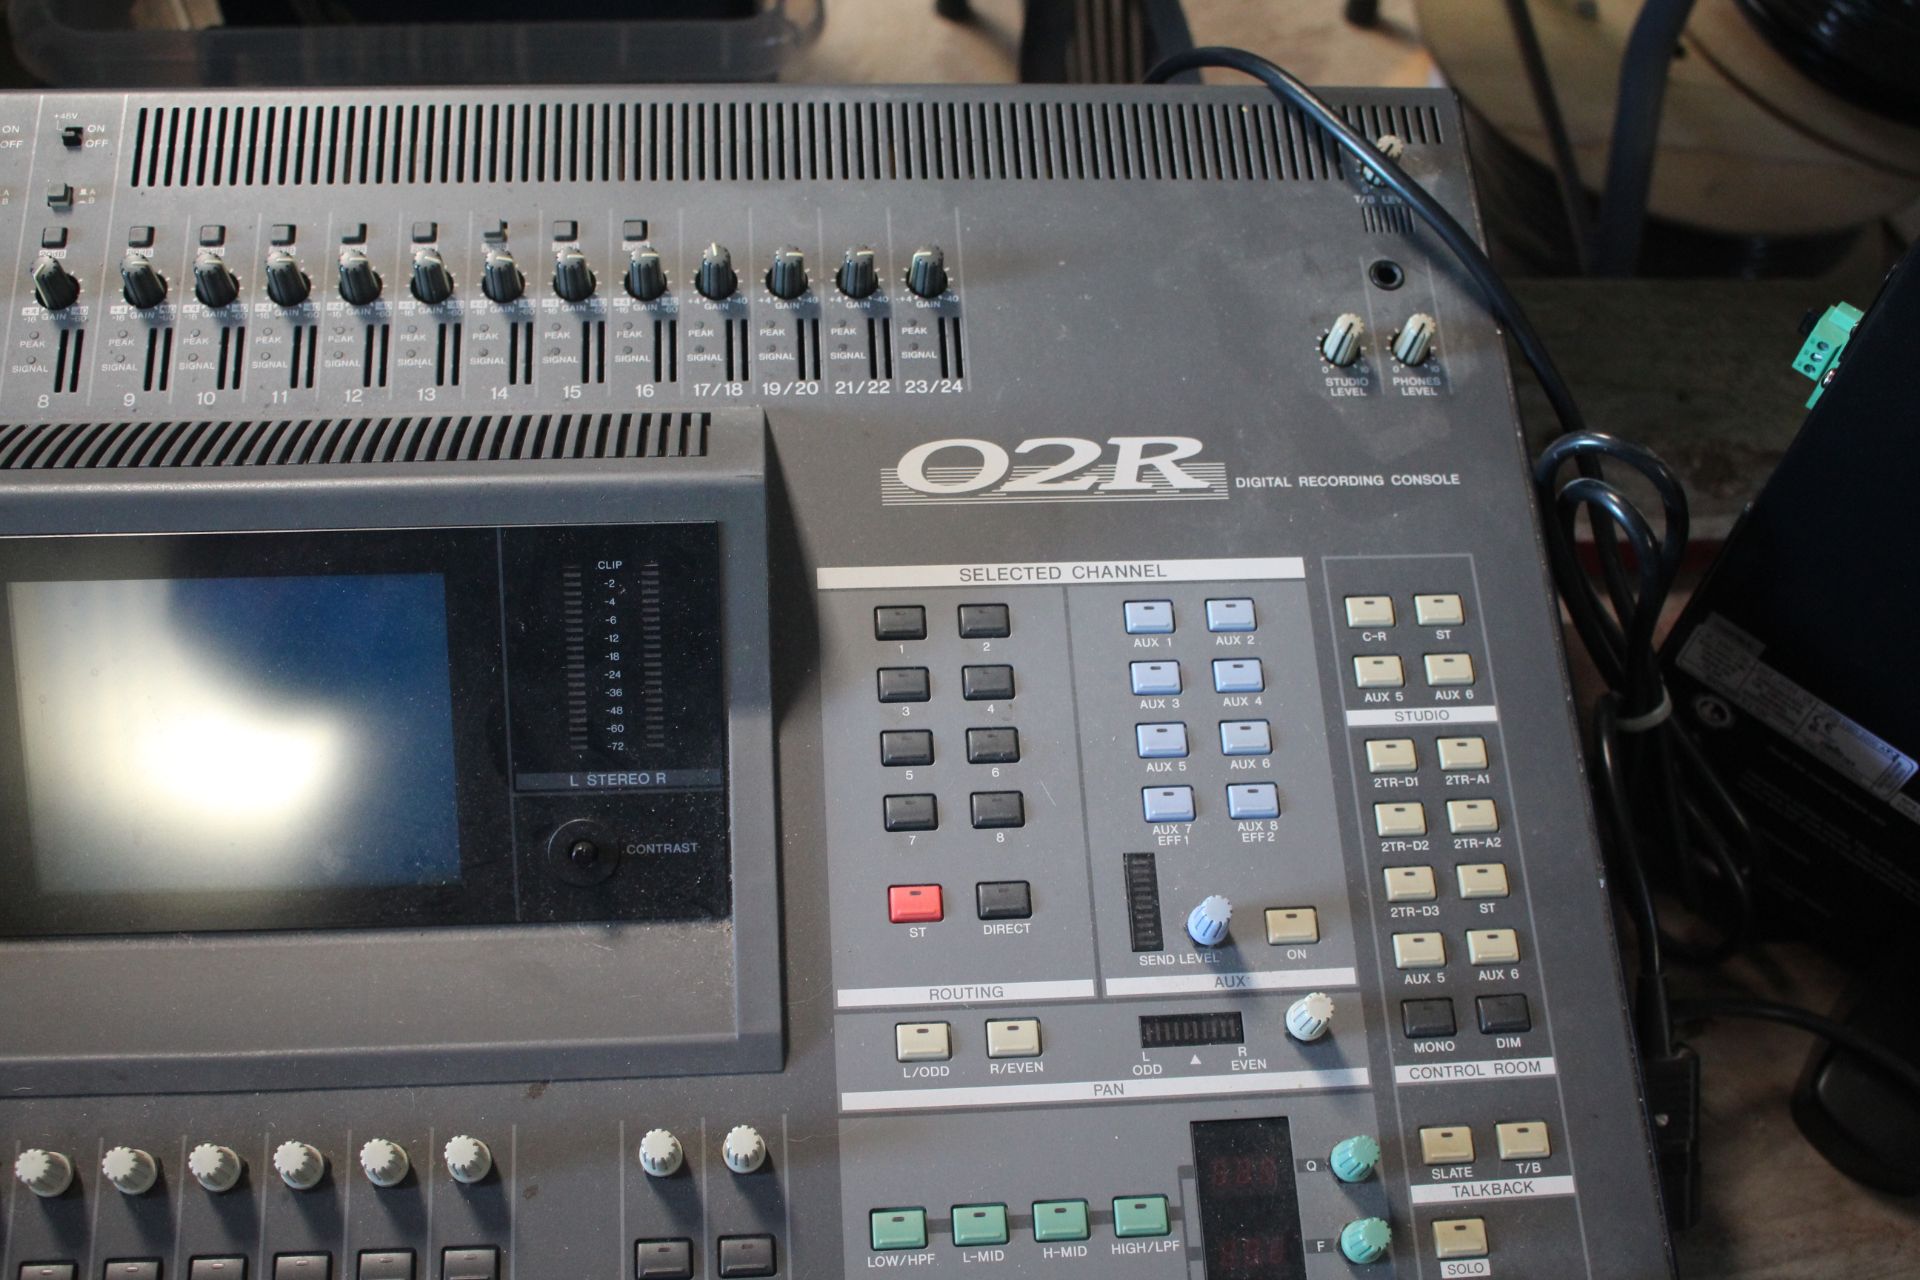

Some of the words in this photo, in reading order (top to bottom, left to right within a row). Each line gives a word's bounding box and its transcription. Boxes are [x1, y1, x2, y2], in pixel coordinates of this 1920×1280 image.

[2, 125, 20, 133] ON
[0, 140, 23, 148] OFF
[86, 140, 108, 148] OFF
[835, 381, 890, 394] 21/22
[905, 380, 963, 393] 23/24
[1326, 378, 1368, 387] STUDIO
[1393, 378, 1440, 386] PHONES
[491, 387, 508, 400] 14
[563, 385, 581, 398] 15
[636, 385, 654, 397] 16
[694, 383, 743, 396] 17/18
[763, 382, 818, 395] 19/20
[1331, 387, 1366, 396] LEVEL
[1401, 387, 1437, 395] LEVEL
[124, 393, 135, 406] 9
[197, 392, 215, 405] 10
[272, 391, 288, 403] 11
[345, 389, 363, 402] 12
[418, 388, 436, 401] 13
[38, 395, 49, 408] 8
[1236, 476, 1291, 488] DIGITAL
[1299, 475, 1384, 487] RECORDING
[1391, 473, 1460, 486] CONSOLE
[598, 561, 622, 569] CLIP
[959, 565, 1061, 582] SELECTED
[1072, 563, 1167, 579] CHANNEL
[1363, 632, 1386, 642] C-R
[1436, 630, 1451, 639] ST
[1134, 639, 1159, 647] AUX
[1216, 637, 1240, 645] AUX
[1248, 636, 1255, 644] 2
[983, 642, 990, 651] 2
[604, 671, 621, 679] -24
[1365, 693, 1389, 702] AUX
[1396, 692, 1403, 701] 5
[1435, 691, 1460, 700] AUX
[1466, 690, 1474, 699] 6
[1140, 700, 1165, 709] AUX
[1172, 699, 1180, 708] 3
[1223, 697, 1248, 706] AUX
[1255, 697, 1262, 705] 4
[903, 707, 910, 716] 3
[987, 704, 994, 713] 4
[1395, 710, 1450, 722] STUDIO
[1147, 763, 1172, 772] AUX
[1179, 762, 1186, 771] 5
[1230, 760, 1256, 769] AUX
[1263, 759, 1270, 768] 6
[906, 771, 913, 780] 5
[992, 768, 999, 777] 6
[570, 776, 579, 786] L
[587, 773, 649, 785] STEREO
[656, 773, 666, 784] R
[1374, 778, 1418, 788] 2TR-D1
[1446, 775, 1490, 785] 2TR-A1
[1153, 825, 1179, 834] AUX
[1185, 825, 1192, 834] 7
[1238, 822, 1263, 831] AUX
[1271, 821, 1278, 830] 8
[909, 836, 916, 845] 7
[996, 833, 1004, 843] 8
[1159, 836, 1181, 846] EFF
[1242, 833, 1264, 842] EFF
[1267, 833, 1275, 841] 2
[627, 843, 698, 854] CONTRAST
[1381, 841, 1429, 852] 2TR-D2
[1454, 838, 1501, 849] 2TR-A2
[1391, 906, 1440, 917] 2TR-D3
[1480, 904, 1495, 913] ST
[910, 928, 926, 938] ST
[984, 924, 1031, 935] DIRECT
[1140, 954, 1175, 966] SEND
[1180, 952, 1220, 964] LEVEL
[1287, 950, 1307, 960] ON
[1405, 974, 1431, 984] AUX
[1438, 973, 1445, 983] 5
[1479, 970, 1505, 981] AUX
[1511, 969, 1519, 979] 6
[1215, 976, 1246, 988] AUX
[929, 986, 1004, 1000] ROUTING
[1414, 1041, 1455, 1053] MONO
[1496, 1038, 1521, 1048] DIM
[1142, 1052, 1150, 1061] L
[1238, 1047, 1247, 1056] R
[990, 1062, 1044, 1074] R/EVEN
[1132, 1064, 1162, 1076] ODD
[1231, 1059, 1267, 1070] EVEN
[903, 1067, 950, 1078] L/ODD
[1410, 1064, 1485, 1080] CONTROL
[1495, 1061, 1541, 1074] ROOM
[1094, 1083, 1125, 1096] PAN
[1306, 1161, 1316, 1172] Q
[1516, 1163, 1541, 1174] T/B
[1432, 1167, 1473, 1180] SLATE
[1452, 1182, 1534, 1198] TALKBACK
[1043, 1246, 1087, 1258] H-MID
[1112, 1240, 1179, 1255] HIGH/LPF
[1317, 1241, 1324, 1252] F
[867, 1254, 936, 1268] LOW/HPF
[963, 1251, 1004, 1263] L-MID
[1448, 1263, 1484, 1275] SOLO
